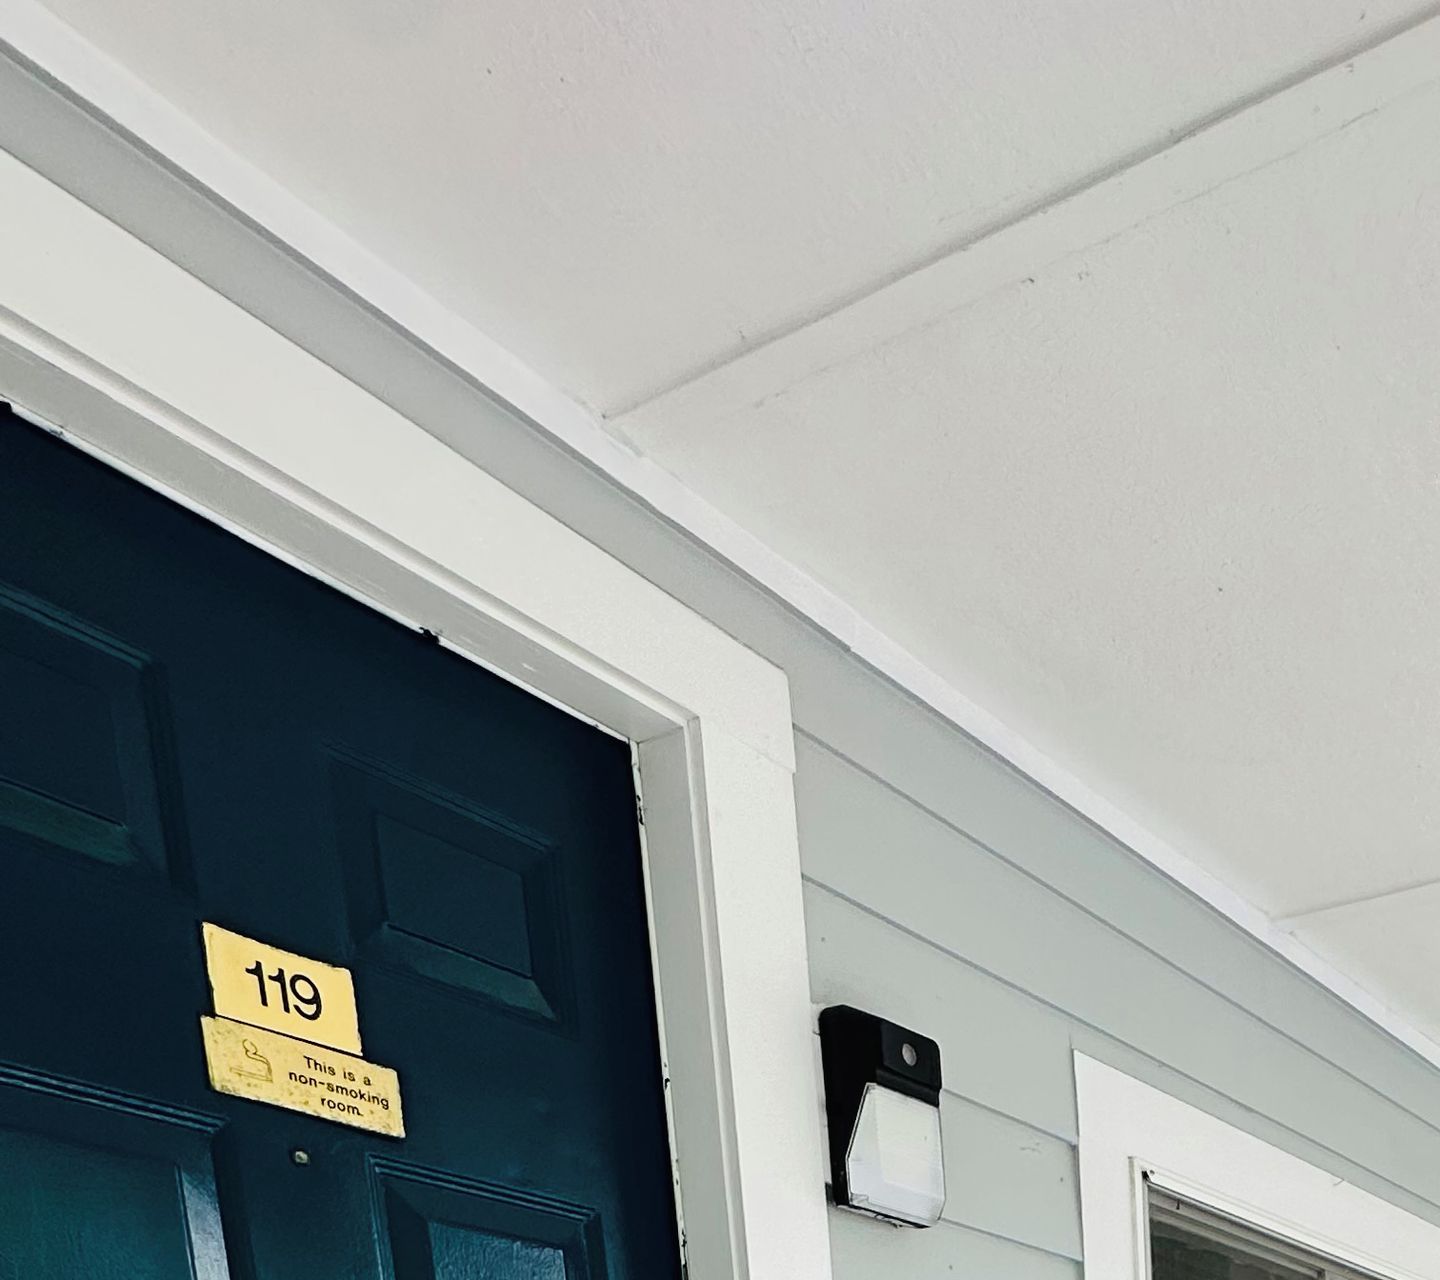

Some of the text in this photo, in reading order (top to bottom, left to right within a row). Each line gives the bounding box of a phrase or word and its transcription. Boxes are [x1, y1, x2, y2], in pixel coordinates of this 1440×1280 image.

[245, 960, 322, 1021] 119
[303, 1055, 371, 1086] This is a
[288, 1071, 390, 1110] non-smoking
